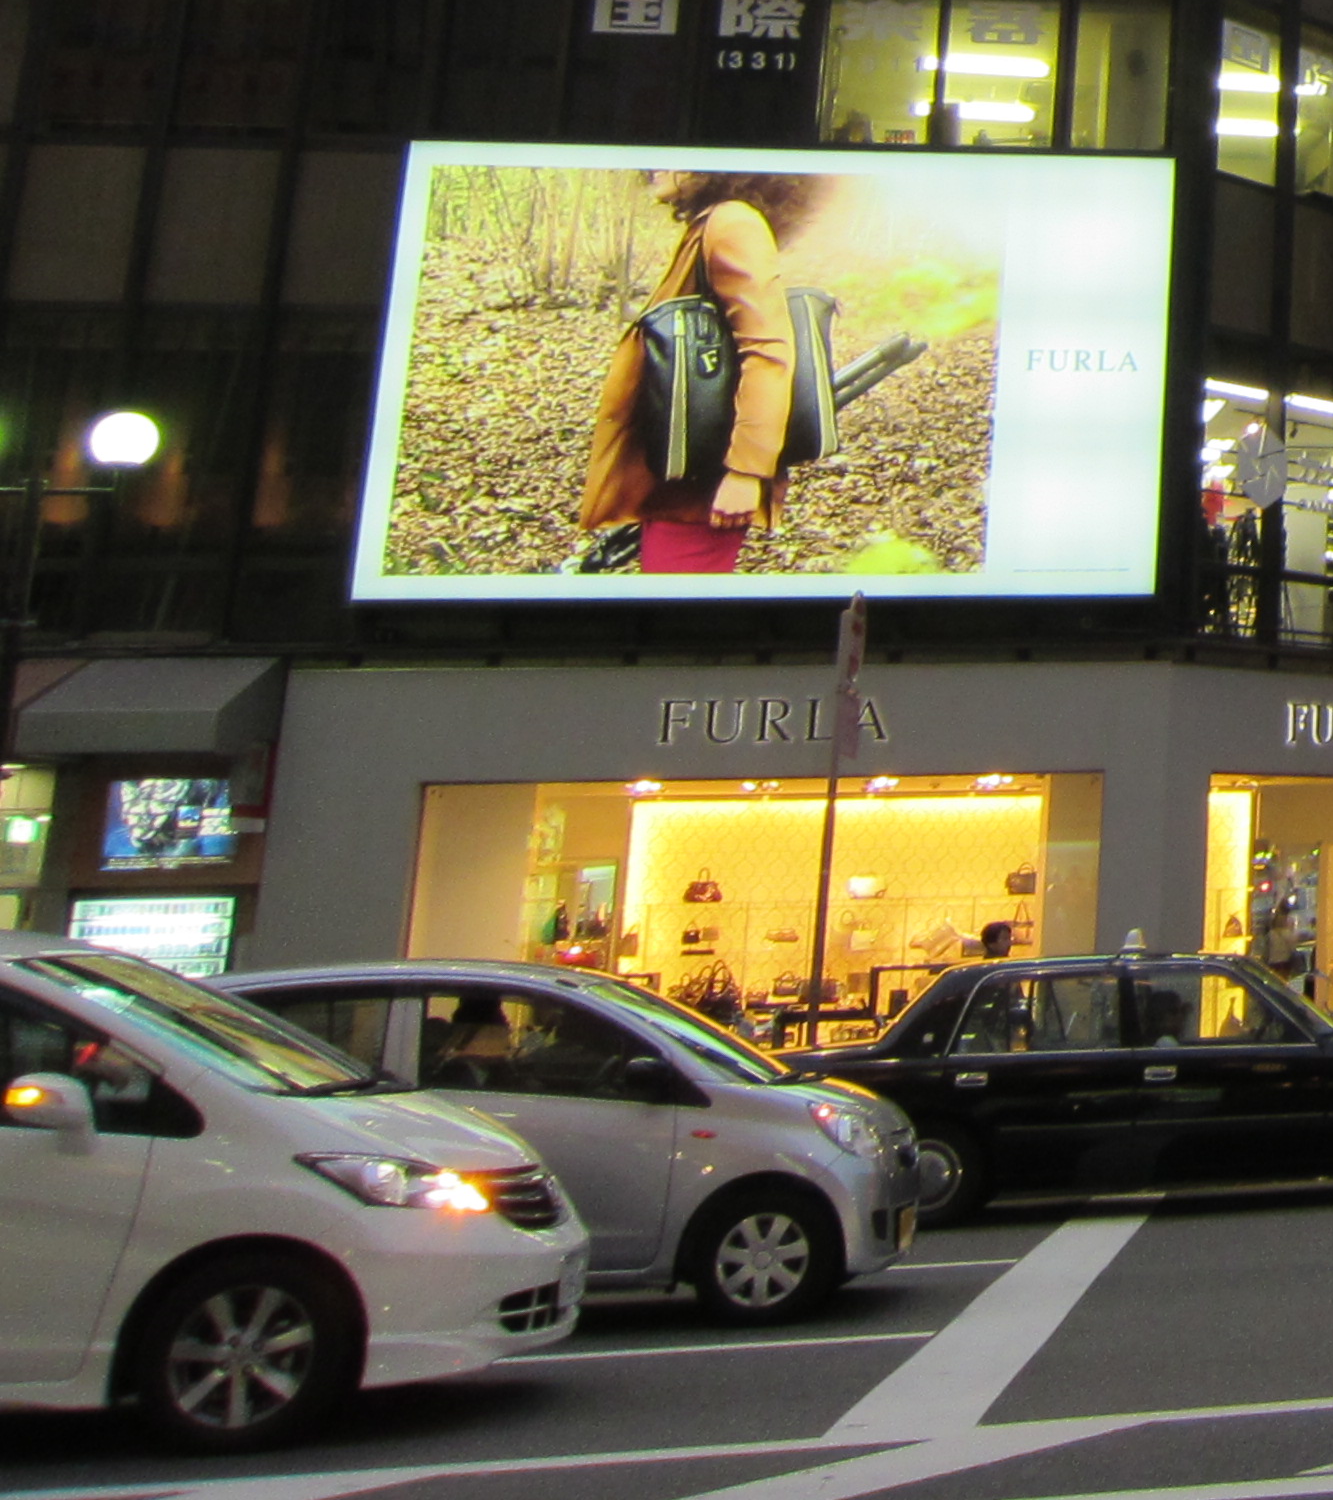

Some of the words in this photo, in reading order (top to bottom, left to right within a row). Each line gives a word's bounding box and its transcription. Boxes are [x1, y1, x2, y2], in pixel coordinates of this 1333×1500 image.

[716, 49, 797, 71] (331)
[1025, 348, 1140, 373] FURLA
[657, 698, 888, 745] FURLA
